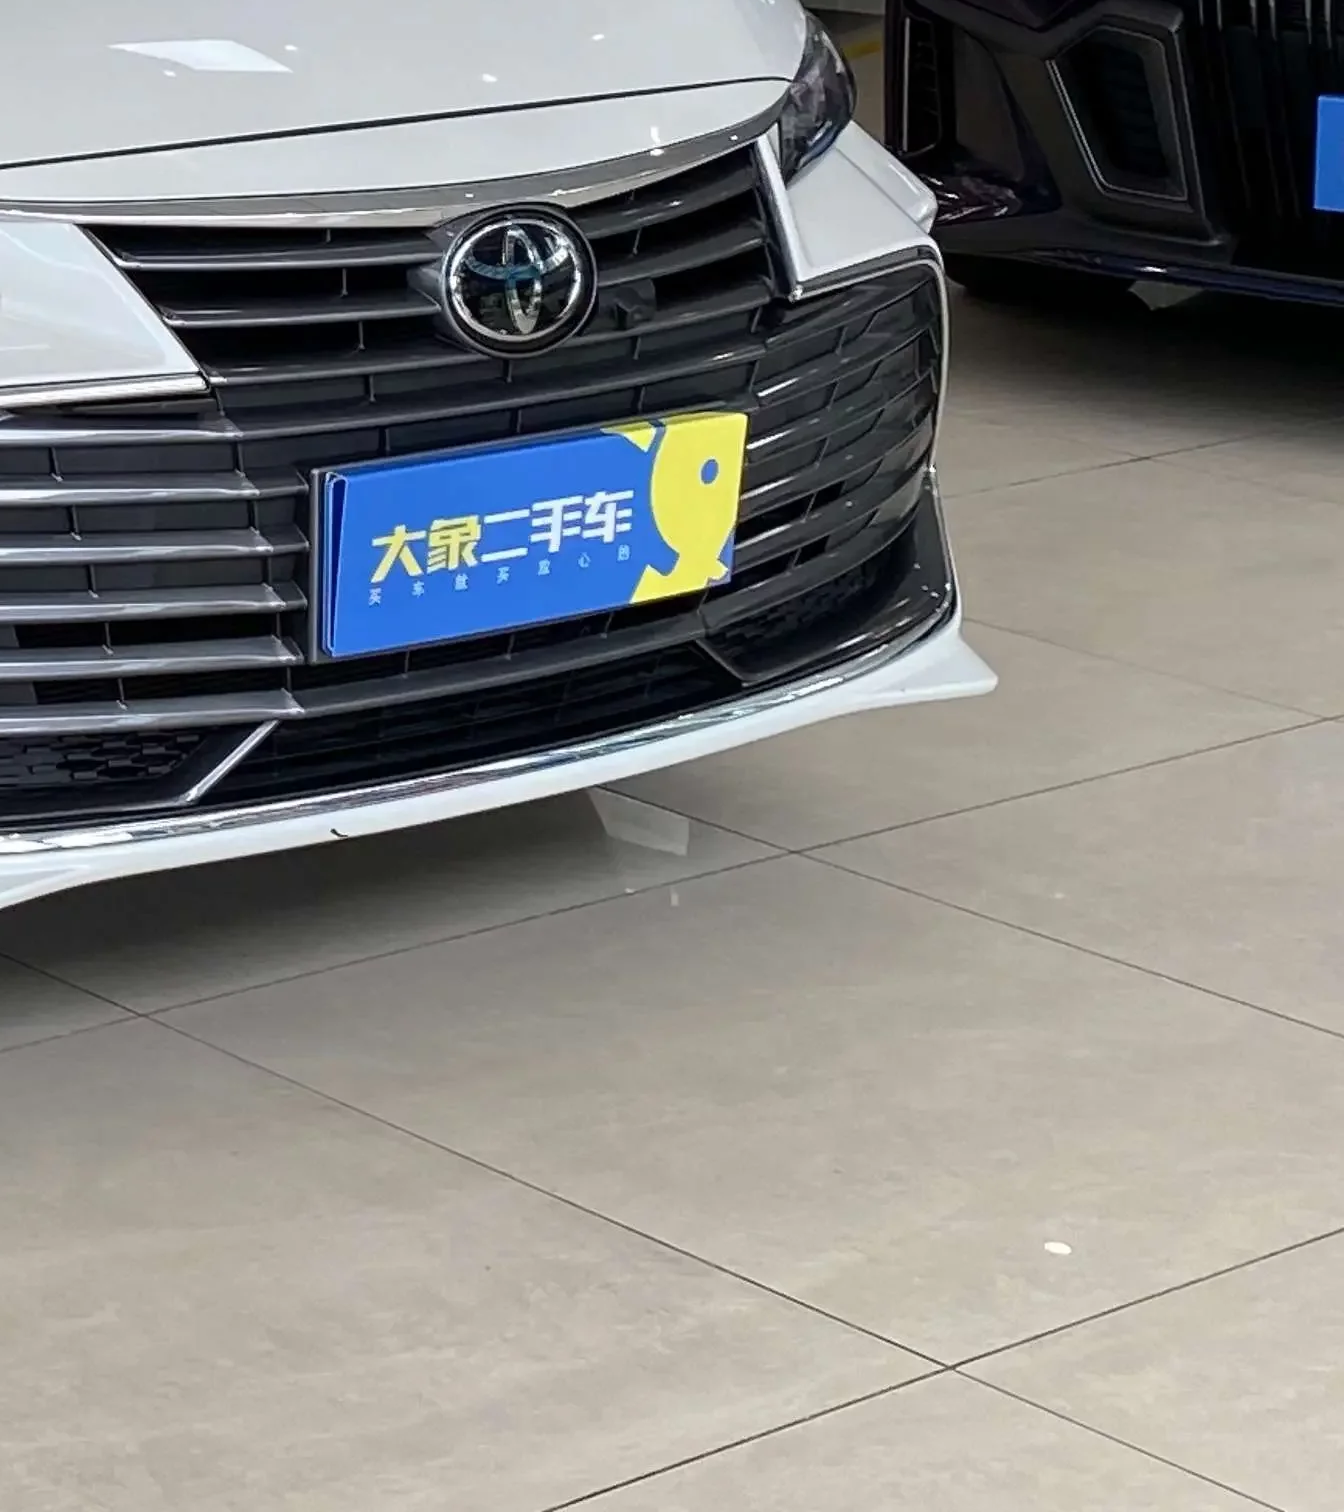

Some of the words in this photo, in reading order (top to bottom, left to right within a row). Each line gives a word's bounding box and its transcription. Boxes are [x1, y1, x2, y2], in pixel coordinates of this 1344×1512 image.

[371, 490, 634, 583] 大象二手车
